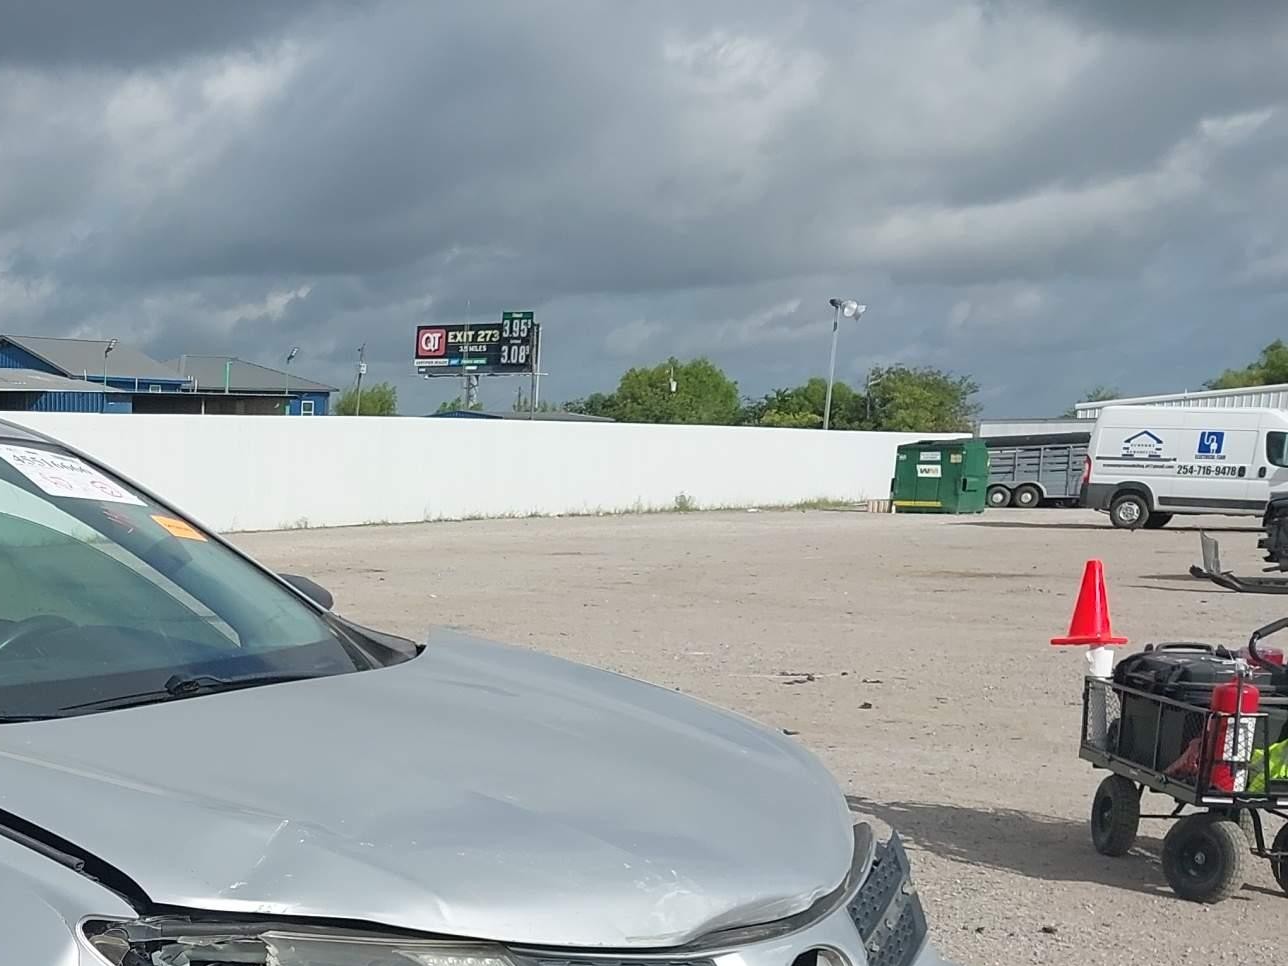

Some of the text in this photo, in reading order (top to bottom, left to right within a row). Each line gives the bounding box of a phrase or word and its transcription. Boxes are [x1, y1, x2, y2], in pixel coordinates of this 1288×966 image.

[421, 332, 442, 352] QT
[447, 329, 500, 343] EXIT 273
[469, 344, 487, 352] MILES
[919, 467, 939, 475] WM
[1176, 465, 1237, 477] 254-716-9478
